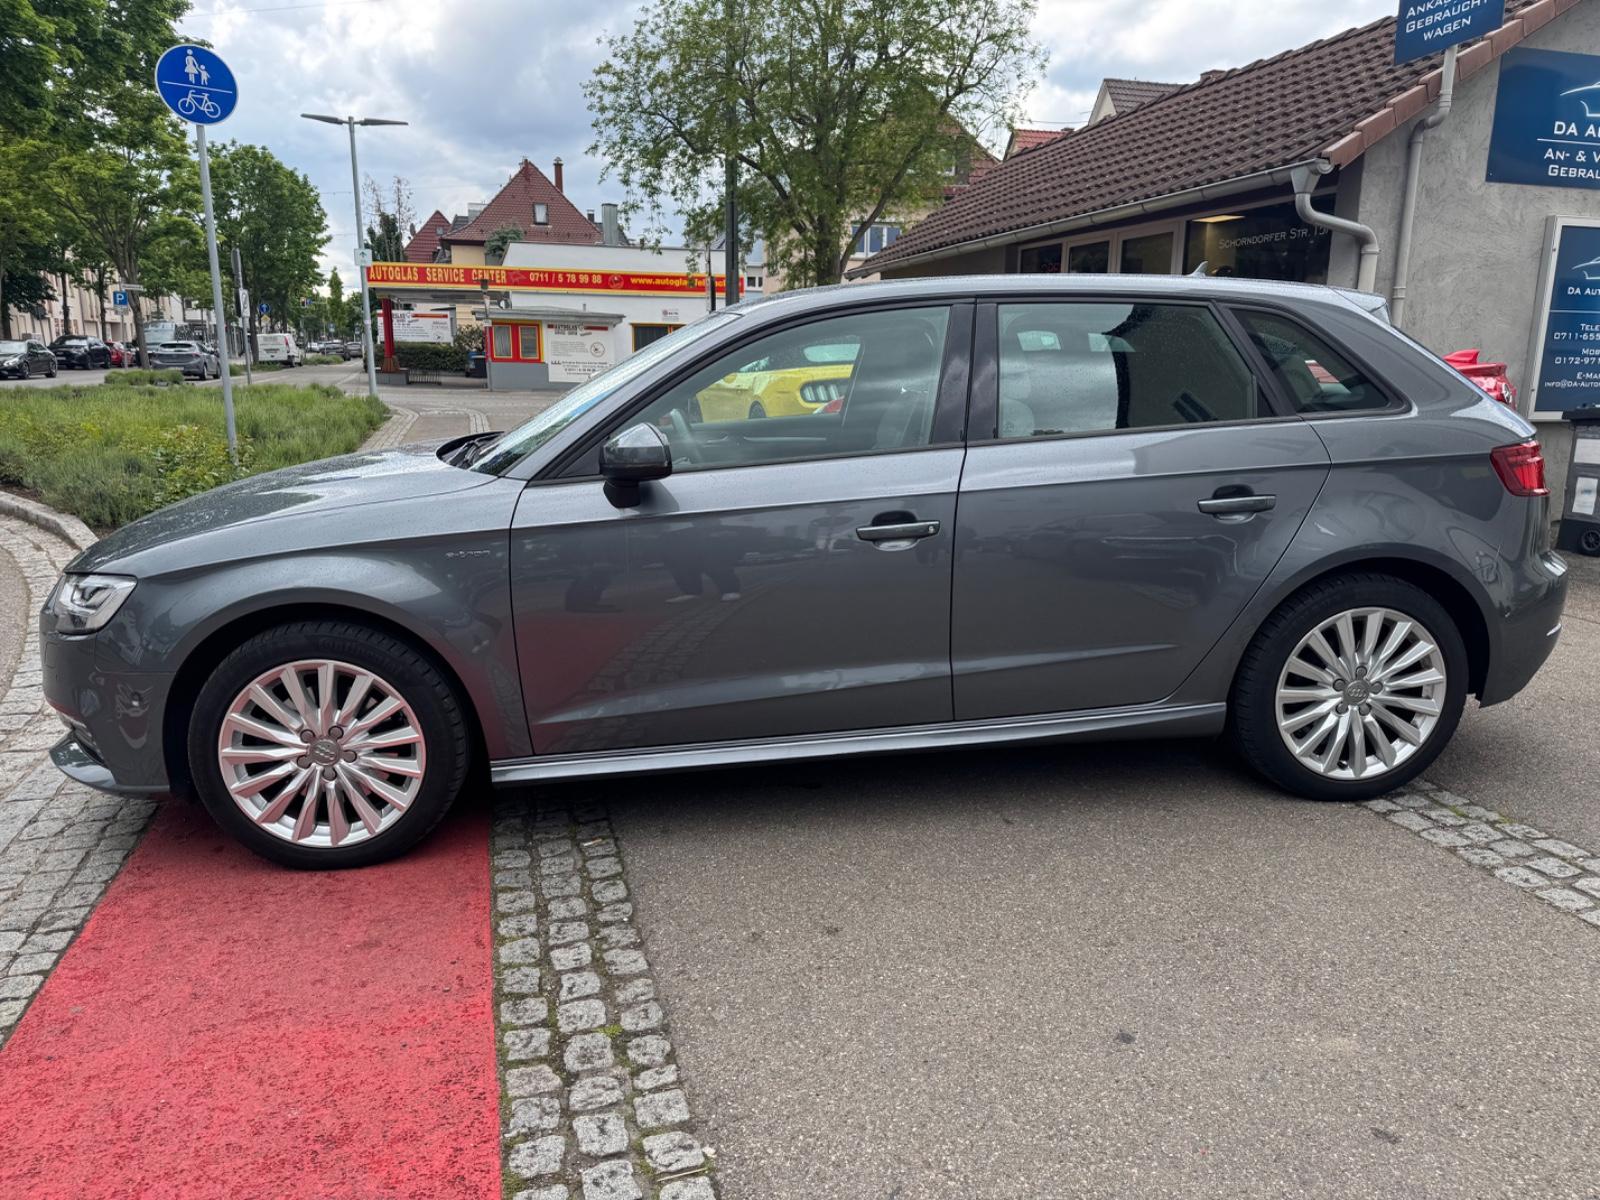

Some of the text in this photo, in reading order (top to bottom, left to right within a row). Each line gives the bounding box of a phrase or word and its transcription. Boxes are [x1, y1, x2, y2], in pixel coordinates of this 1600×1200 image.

[1423, 16, 1471, 40] WAGEN
[1553, 121, 1578, 136] DA
[1575, 150, 1587, 162] &
[369, 264, 419, 281] AUTOGLAS
[426, 267, 465, 282] SERVICE
[471, 269, 507, 284] CENTER
[529, 272, 549, 282] 0711
[1567, 286, 1581, 295] DA
[116, 293, 125, 304] P
